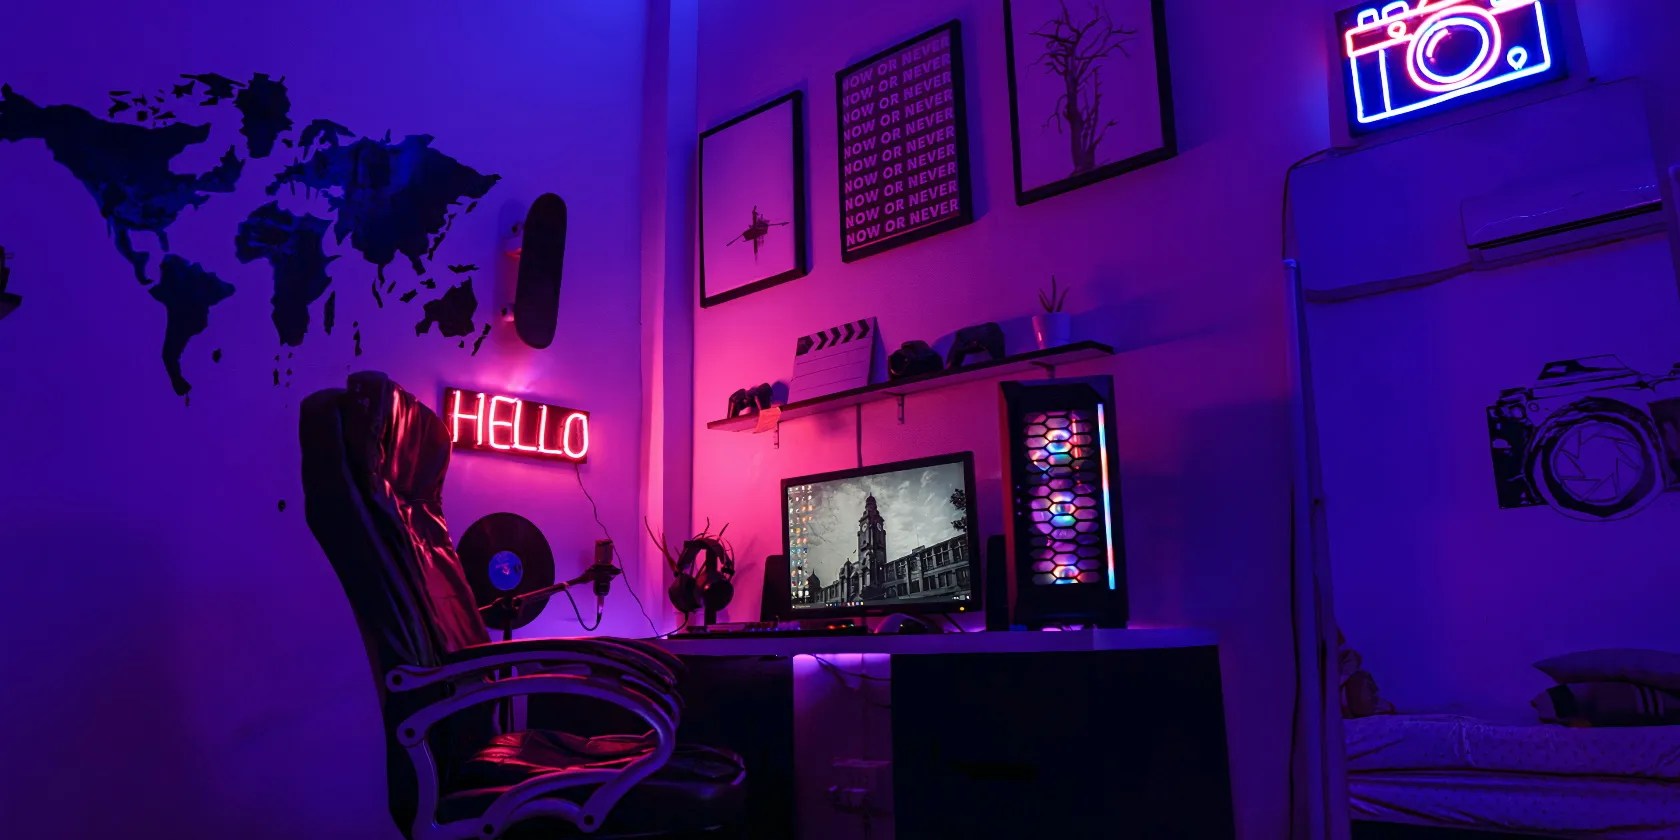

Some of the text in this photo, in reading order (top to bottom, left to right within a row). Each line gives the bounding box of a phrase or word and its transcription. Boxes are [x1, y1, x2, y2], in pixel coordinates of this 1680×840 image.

[878, 59, 897, 75] OR
[903, 39, 949, 63] NEVER
[879, 77, 898, 93] OR
[903, 54, 950, 81] NEVER
[880, 94, 899, 110] OR
[904, 72, 951, 99] NEVER
[844, 90, 952, 142] NOW OR NEVER
[845, 108, 953, 159] NOW OR NEVER
[845, 126, 954, 177] NOW OR NEVER
[846, 144, 955, 194] NOW OR NEVER
[846, 162, 956, 211] NOW OR NEVER
[846, 180, 957, 229] NOW OR NEVER
[847, 199, 958, 246] NOW OR NEVER
[452, 390, 589, 459] HELLO
